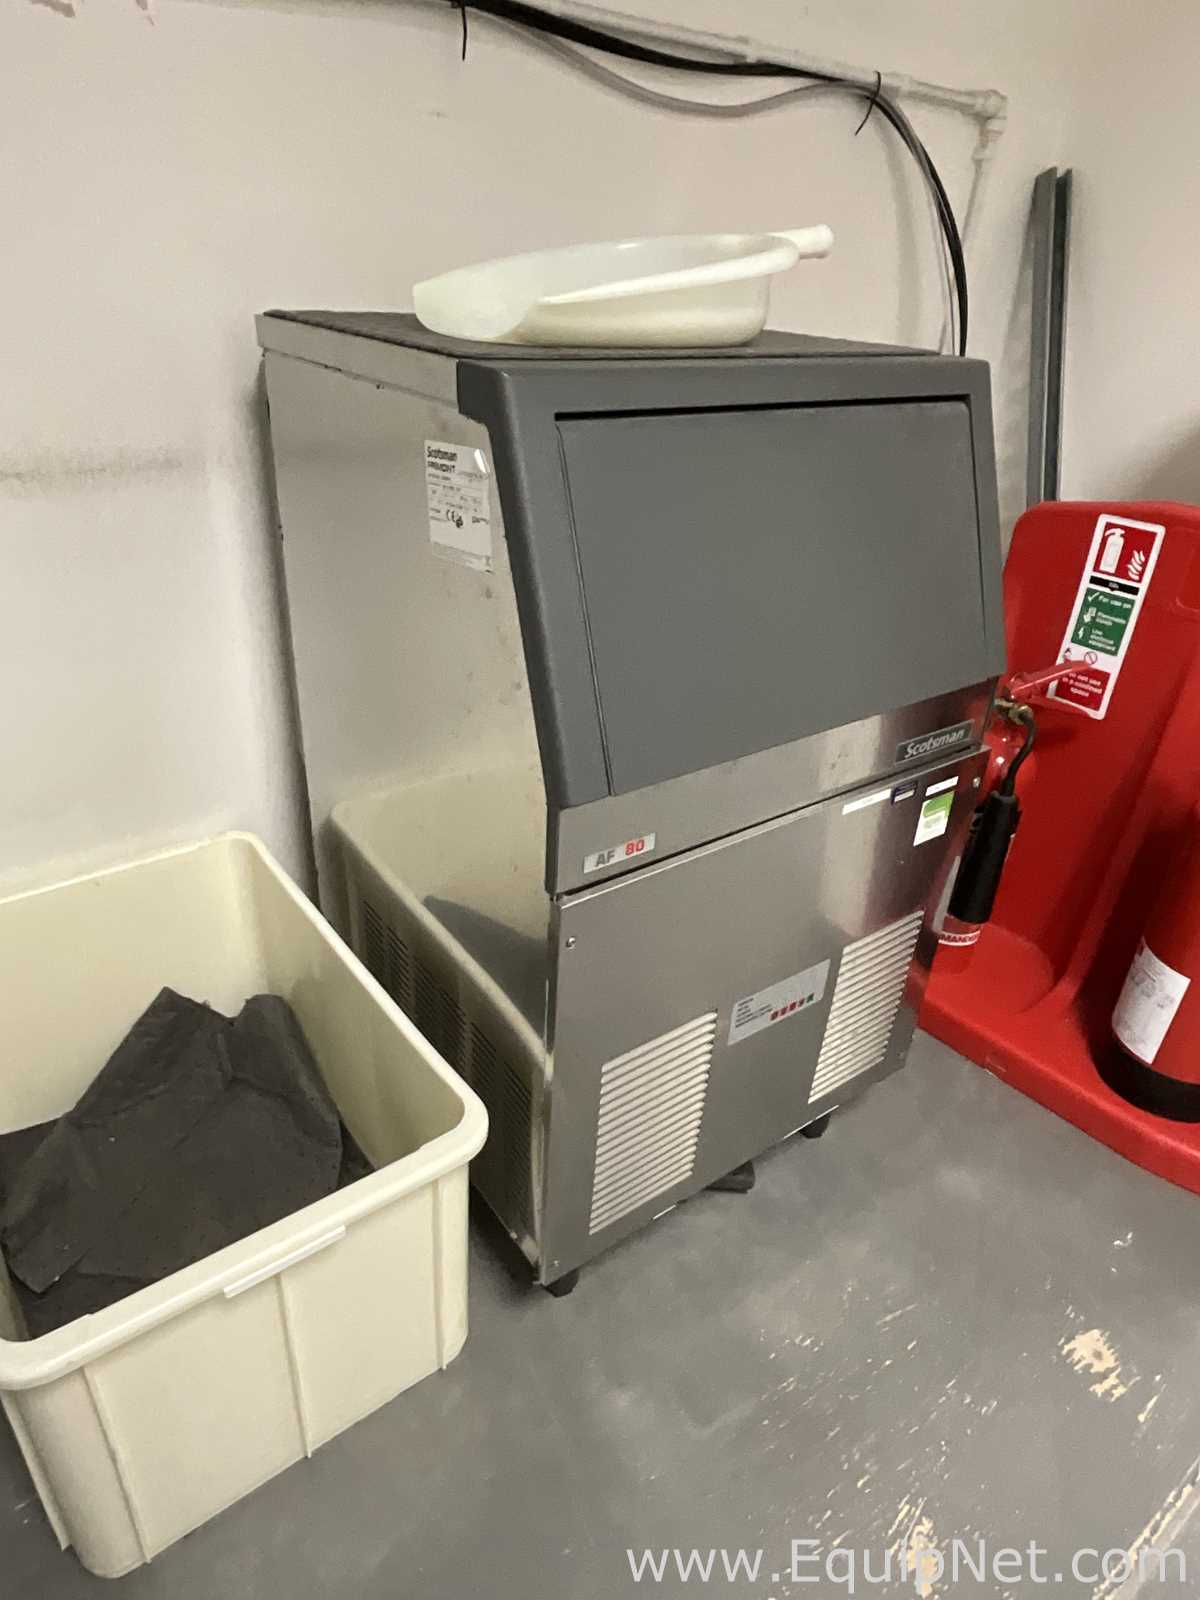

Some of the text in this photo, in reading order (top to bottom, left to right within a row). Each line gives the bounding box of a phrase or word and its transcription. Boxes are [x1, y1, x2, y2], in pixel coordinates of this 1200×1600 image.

[904, 729, 965, 758] Scotsman
[595, 839, 645, 868] AF 80
